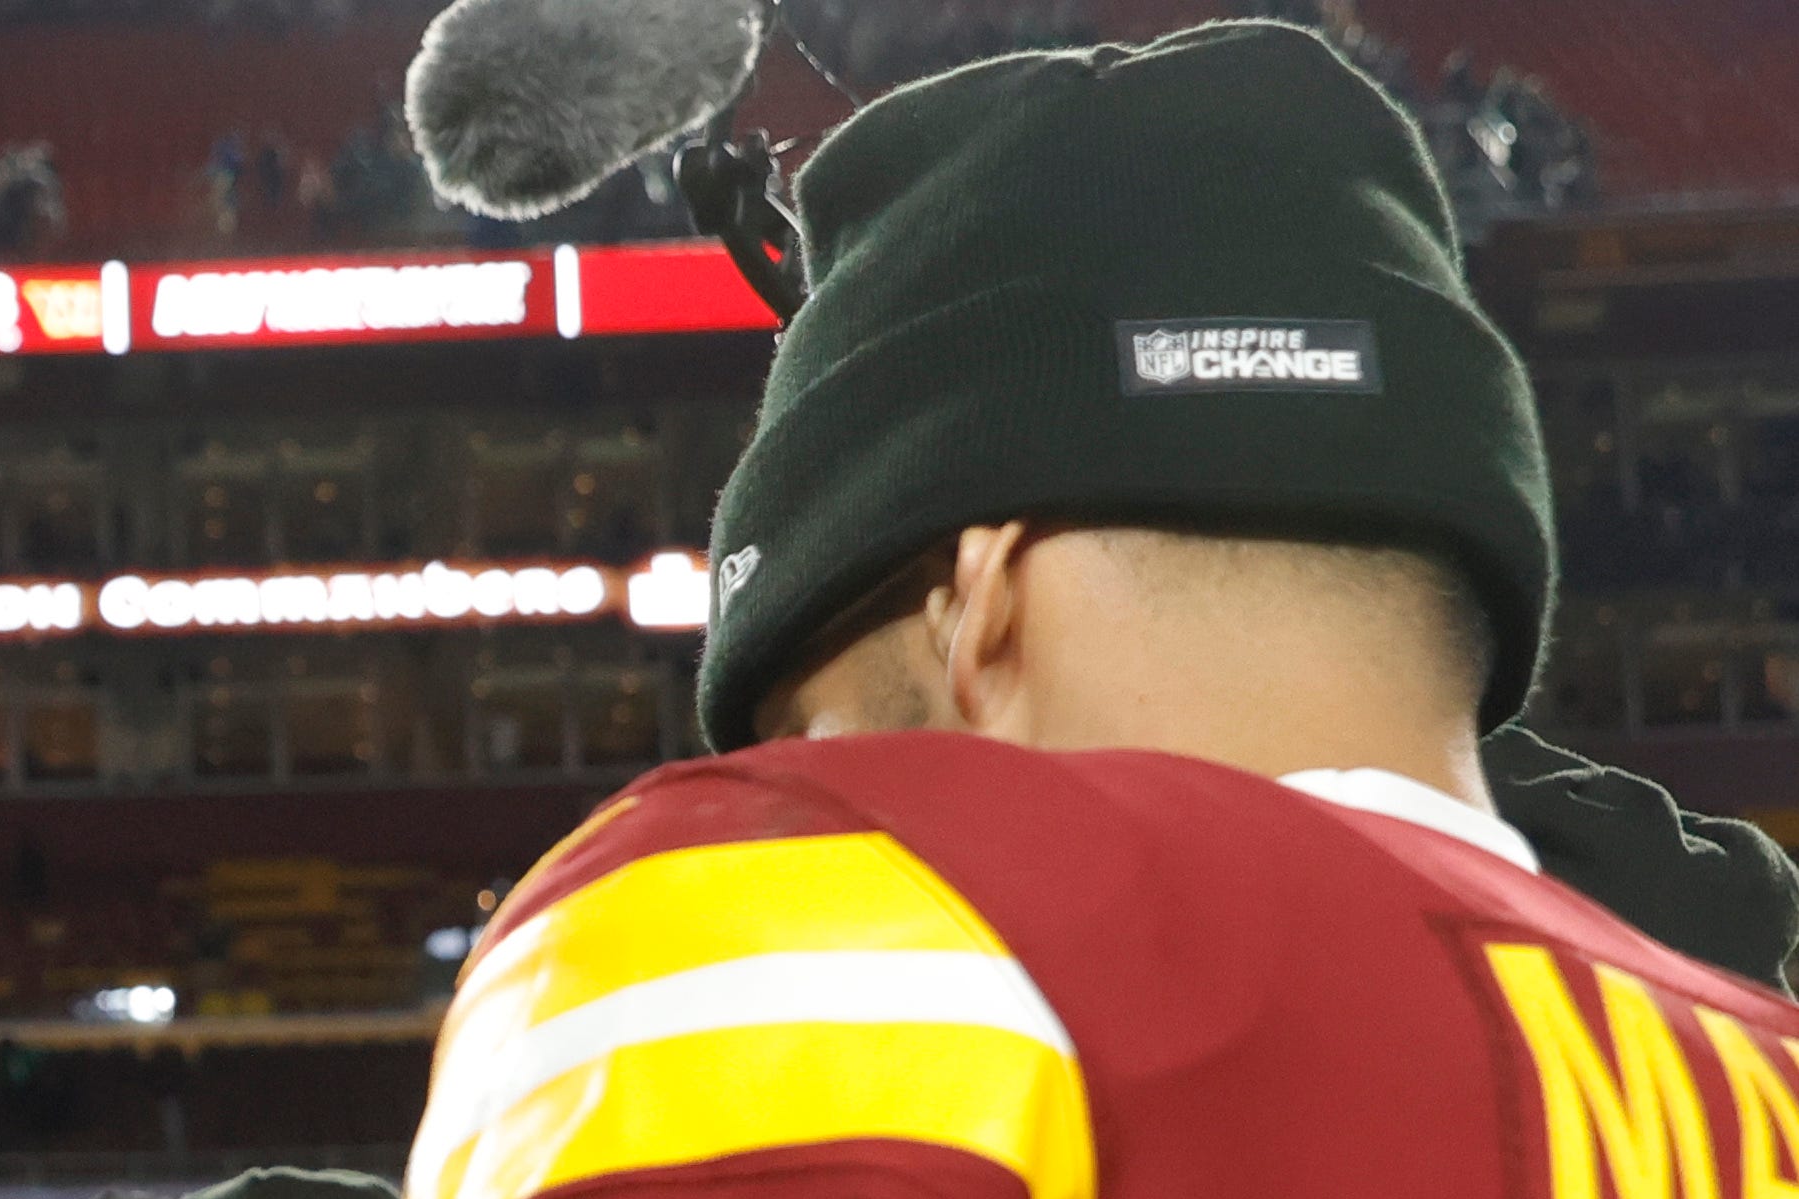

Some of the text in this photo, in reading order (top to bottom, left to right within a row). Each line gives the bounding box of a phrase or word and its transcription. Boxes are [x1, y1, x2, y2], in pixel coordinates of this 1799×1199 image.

[1190, 328, 1306, 350] INSPIRE
[1140, 350, 1185, 375] NFL
[1191, 349, 1362, 381] CHANGE
